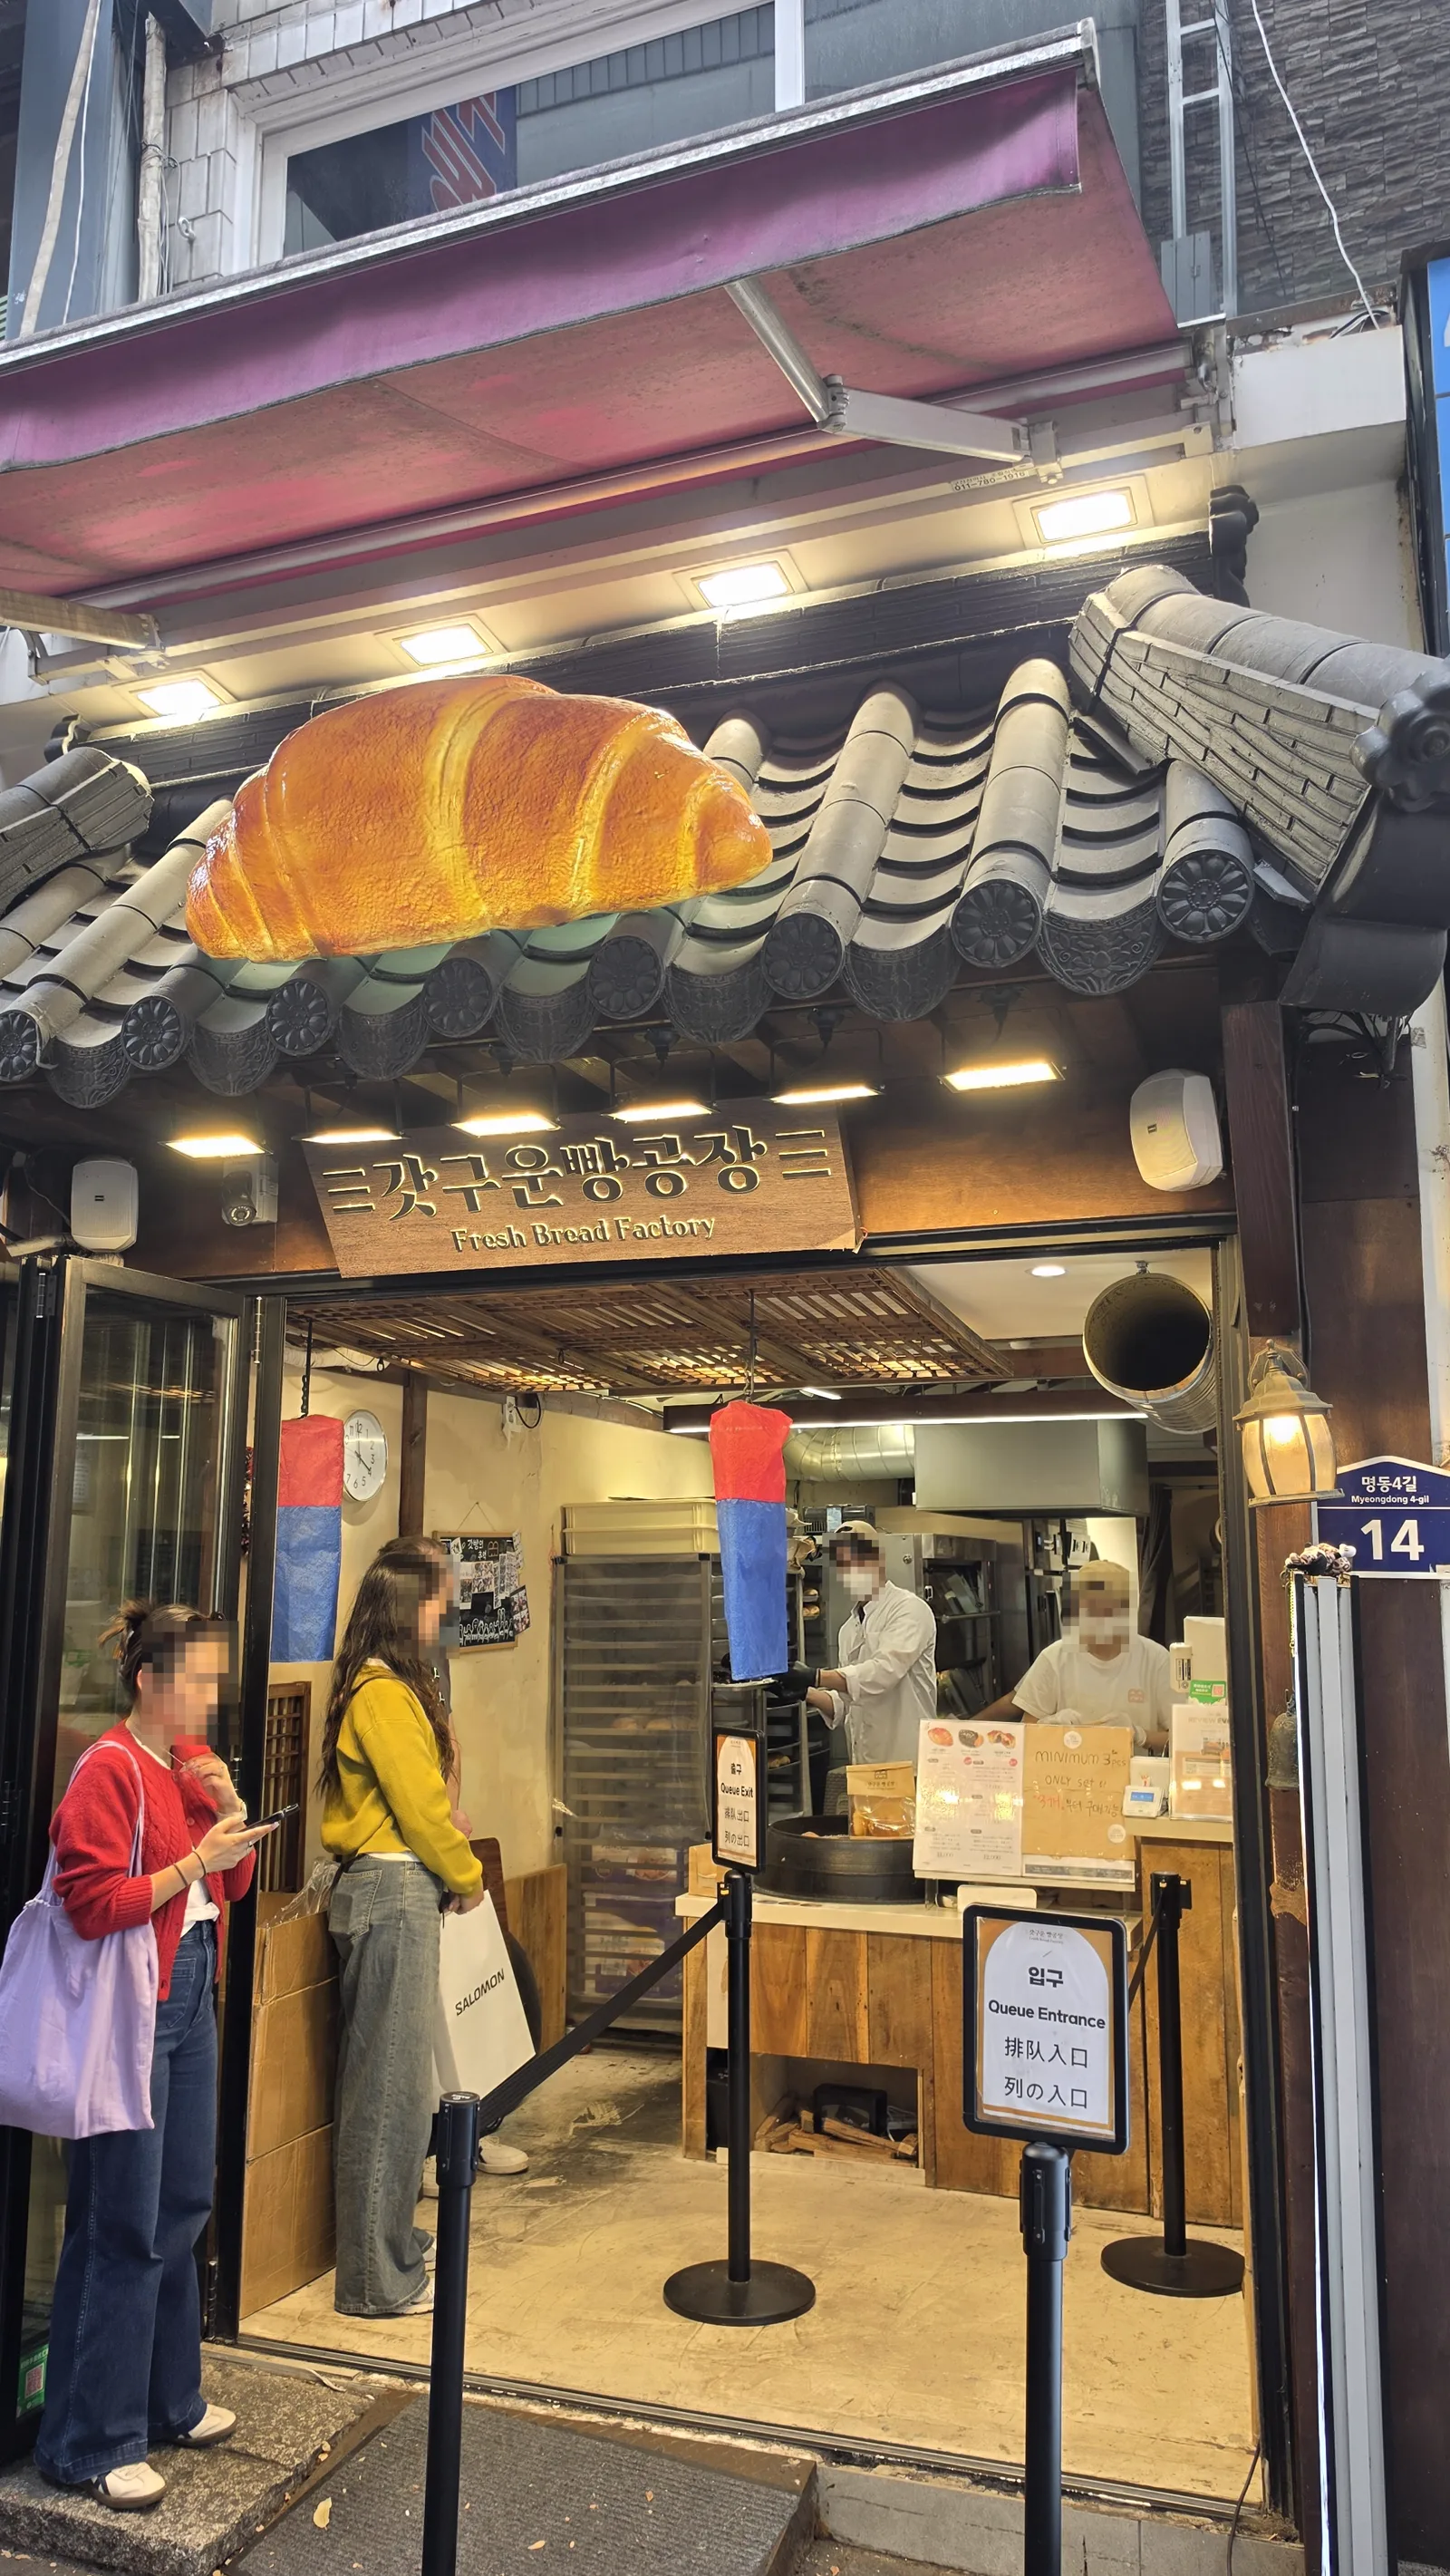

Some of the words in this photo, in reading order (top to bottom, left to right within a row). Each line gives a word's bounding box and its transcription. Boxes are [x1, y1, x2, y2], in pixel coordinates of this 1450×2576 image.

[450, 1228, 527, 1253] Fresh
[531, 1218, 611, 1246] Bread
[614, 1214, 715, 1241] Factory
[371, 1454, 375, 1465] 3
[346, 1473, 351, 1484] 7
[353, 1478, 359, 1489] 6
[362, 1477, 366, 1487] 5
[1361, 1475, 1417, 1493] 명동4길
[1351, 1495, 1408, 1506] Myeongdong
[1409, 1495, 1429, 1505] 4-gil
[1360, 1519, 1425, 1561] 14
[1035, 1750, 1099, 1765] MINIMUM
[1103, 1753, 1111, 1766] 3
[720, 1782, 740, 1796] Queue
[740, 1786, 754, 1798] Exit
[1045, 1775, 1071, 1787] ONLY
[1078, 1777, 1095, 1788] set
[1028, 1966, 1064, 1988] 입구
[455, 1968, 505, 2017] SALOMON
[988, 1999, 1035, 2019] Queue
[1038, 2006, 1106, 2029] Entrance
[1004, 2036, 1088, 2068] 排队入口
[1004, 2076, 1088, 2109] 列の入口
